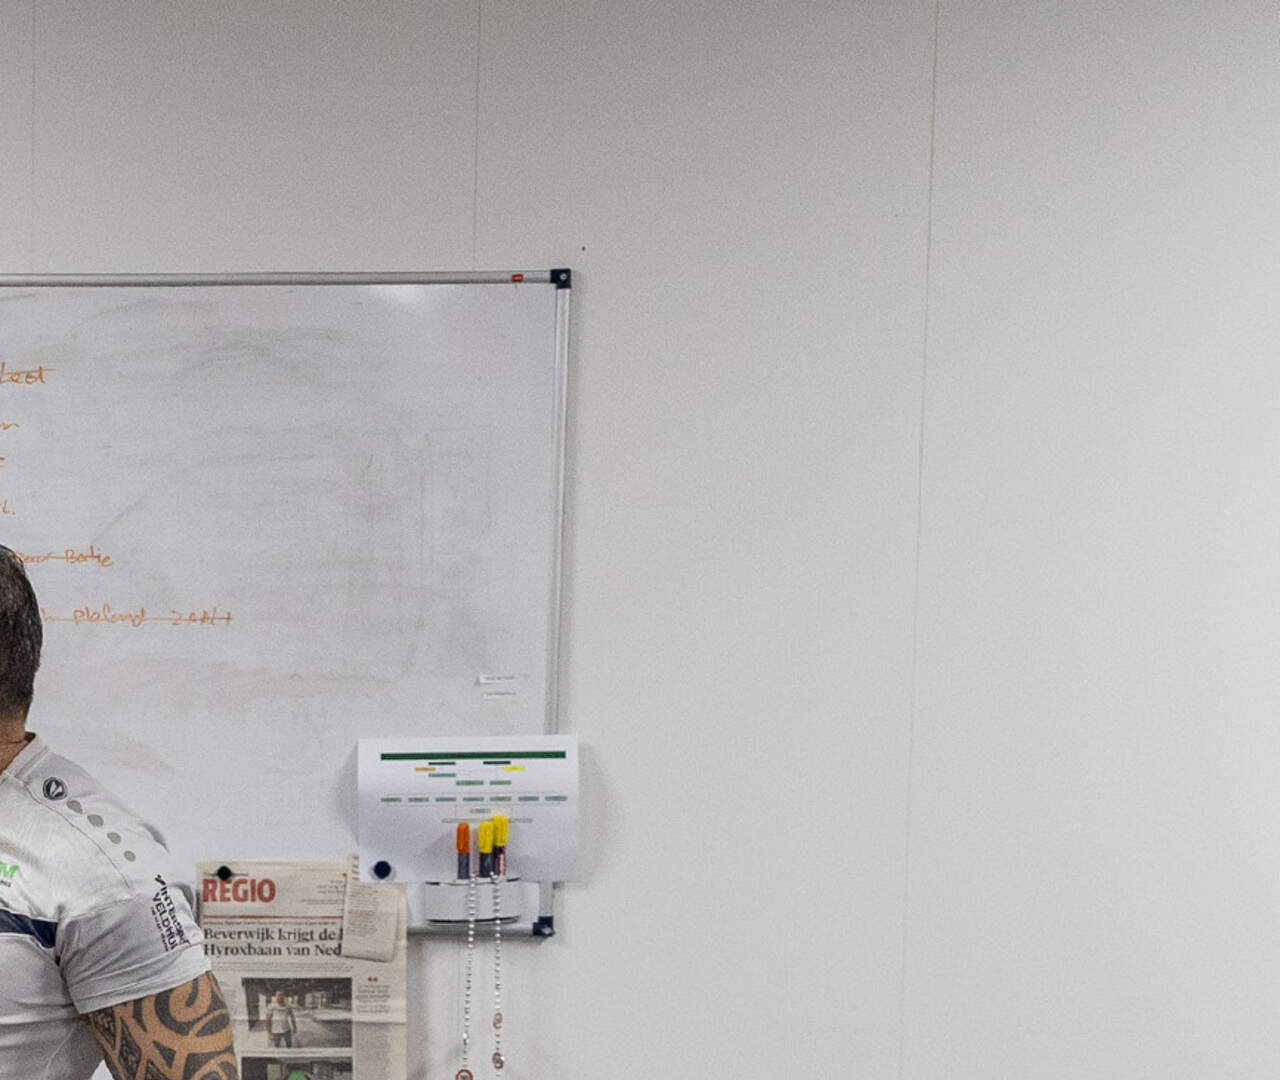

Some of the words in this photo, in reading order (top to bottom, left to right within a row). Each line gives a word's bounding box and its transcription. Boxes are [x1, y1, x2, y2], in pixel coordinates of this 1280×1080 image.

[202, 877, 277, 903] REGIO
[152, 891, 178, 951] VELDHUI
[203, 927, 274, 943] Beverwijk
[278, 927, 314, 943] krijgt
[318, 928, 337, 941] de
[204, 943, 282, 958] Hyroxbaan
[286, 948, 311, 956] van
[315, 944, 342, 957] Ned
